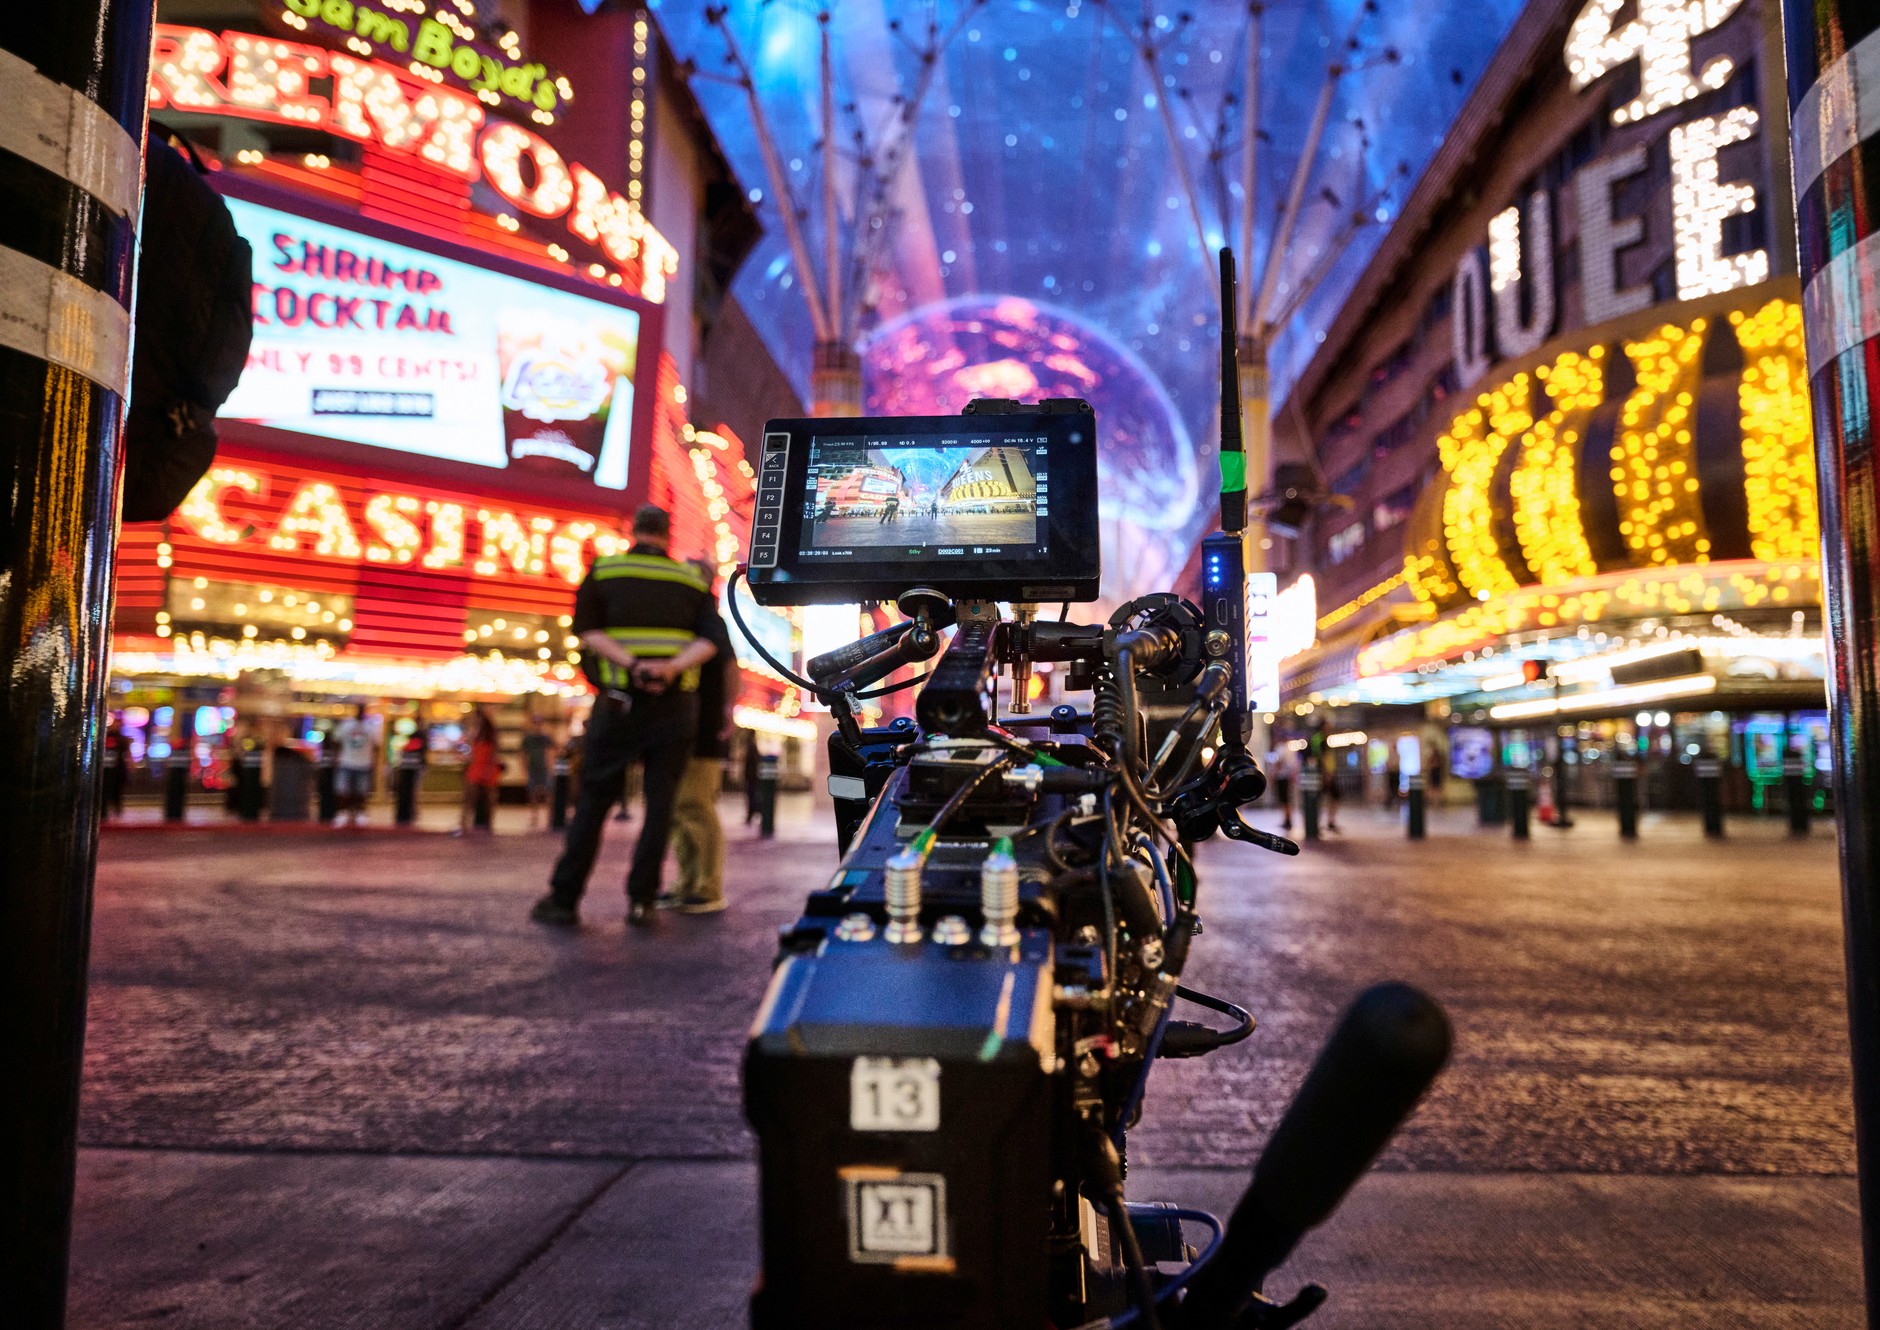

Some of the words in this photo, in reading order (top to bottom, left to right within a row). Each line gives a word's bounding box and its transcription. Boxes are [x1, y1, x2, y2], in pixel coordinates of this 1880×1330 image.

[411, 17, 557, 112] Boyd's
[150, 24, 680, 304] REMONT
[271, 232, 444, 295] SHRIMP
[1451, 105, 1769, 390] QUEE
[251, 281, 456, 336] COCKTAIL
[245, 349, 312, 373] NLY
[328, 352, 363, 377] 99
[952, 470, 992, 487] UEENS
[866, 1080, 922, 1120] 13
